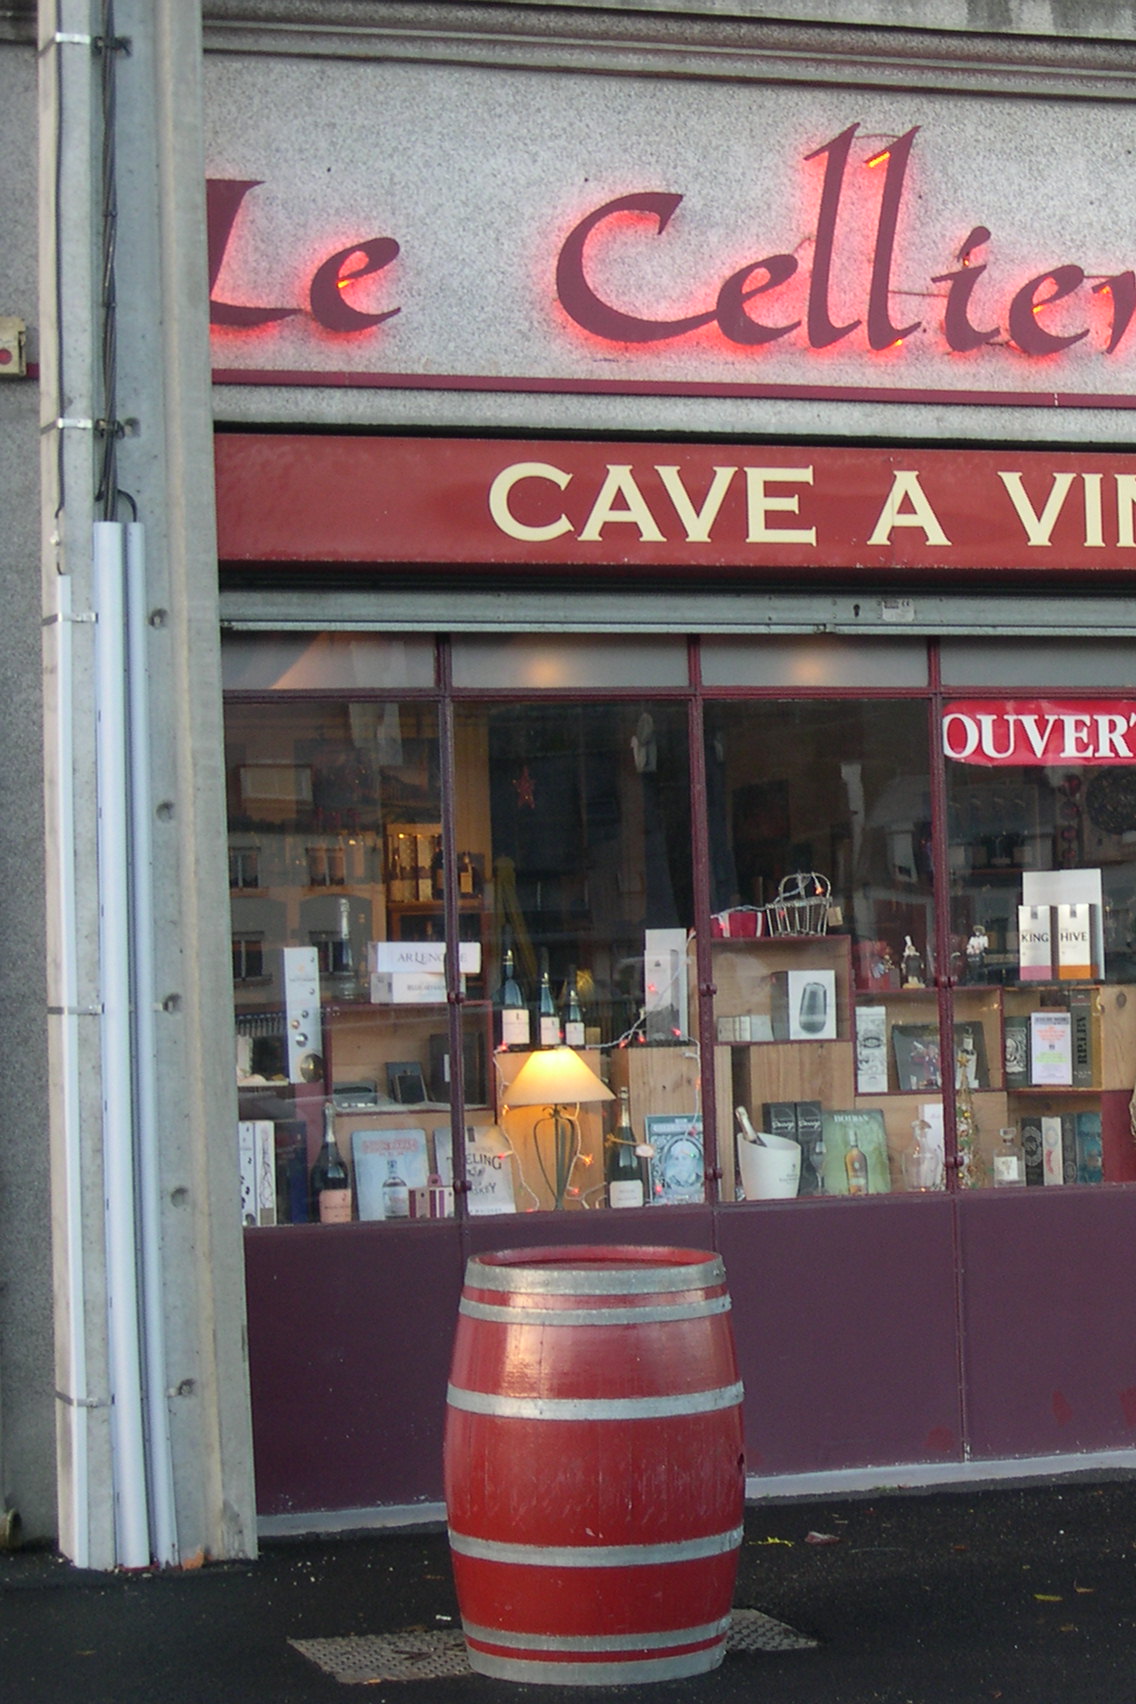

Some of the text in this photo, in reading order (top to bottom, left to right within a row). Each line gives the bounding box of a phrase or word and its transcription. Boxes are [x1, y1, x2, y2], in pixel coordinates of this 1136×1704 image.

[206, 178, 401, 333] Le
[487, 461, 817, 547] CAVE
[867, 469, 951, 547] A
[1021, 932, 1049, 943] KING
[1060, 931, 1088, 942] HIVE
